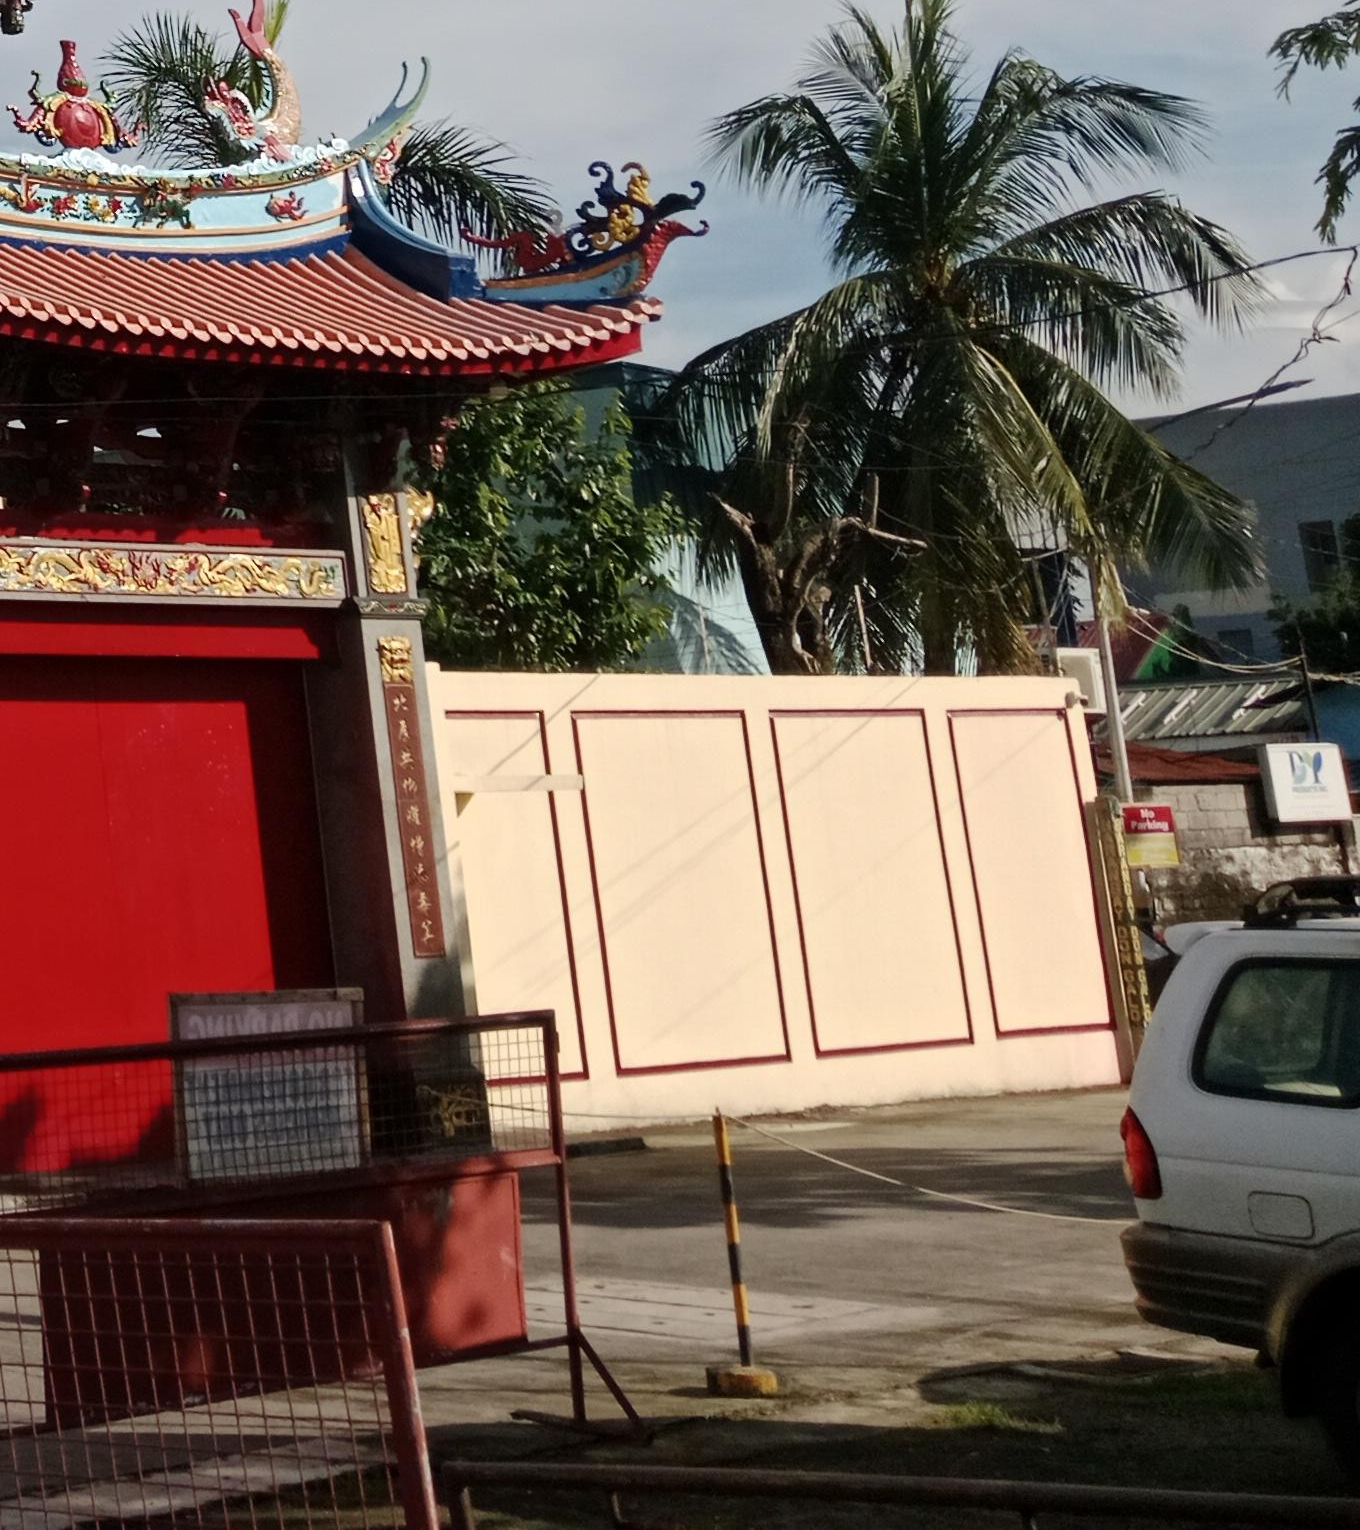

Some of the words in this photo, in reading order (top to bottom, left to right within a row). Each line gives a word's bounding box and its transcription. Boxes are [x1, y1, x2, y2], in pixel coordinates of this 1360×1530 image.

[1131, 818, 1169, 831] Parking
[1140, 808, 1155, 819] No
[1118, 926, 1132, 964] DON
[1130, 926, 1143, 965] DON
[1124, 970, 1140, 1022] GALO
